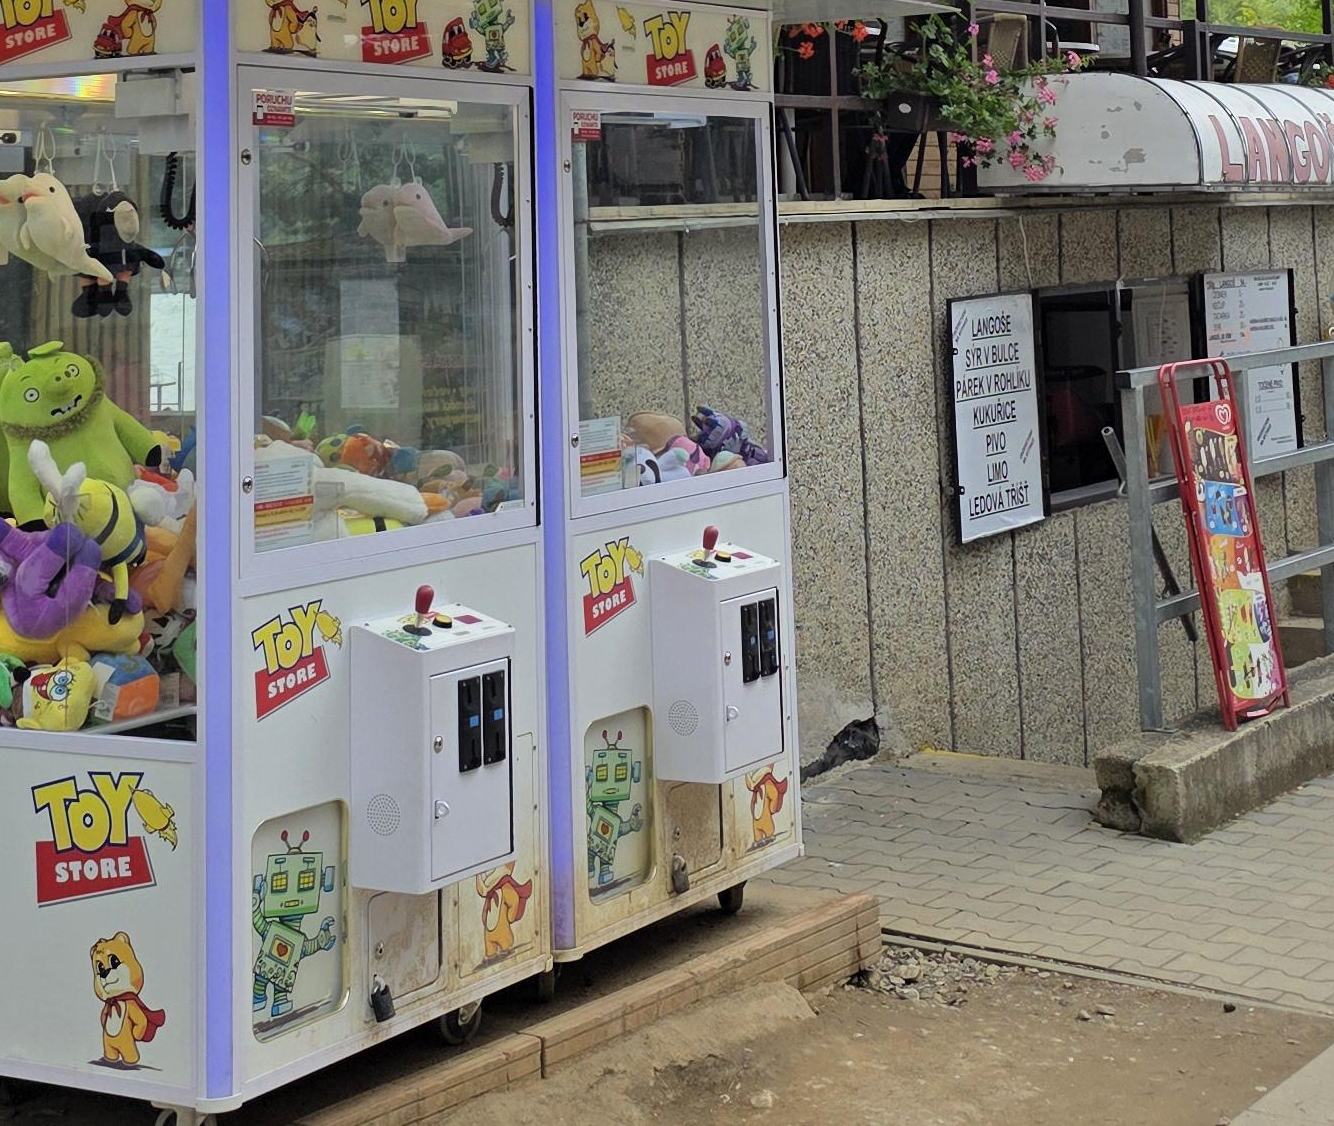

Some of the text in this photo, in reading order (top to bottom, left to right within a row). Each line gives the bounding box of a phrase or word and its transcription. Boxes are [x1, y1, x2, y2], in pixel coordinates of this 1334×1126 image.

[5, 24, 57, 49] STORE
[373, 35, 420, 56] STORE
[643, 11, 691, 61] TOY
[655, 61, 688, 80] STORE
[971, 310, 1011, 337] LANGOŠE
[965, 342, 1020, 367] SÝR V BULCE
[956, 365, 1031, 398] PÁREK V ROHLÍKU
[973, 398, 1016, 427] KUKUŘICE
[986, 431, 1007, 453] PIVO
[987, 460, 1008, 483] LIMO
[969, 486, 1005, 517] LEDOVÁ
[580, 536, 630, 599] TOY
[592, 589, 627, 619] STORE
[251, 598, 323, 677] TOY
[268, 662, 317, 699] STORE
[31, 771, 144, 854] TOY
[55, 856, 132, 883] STORE
